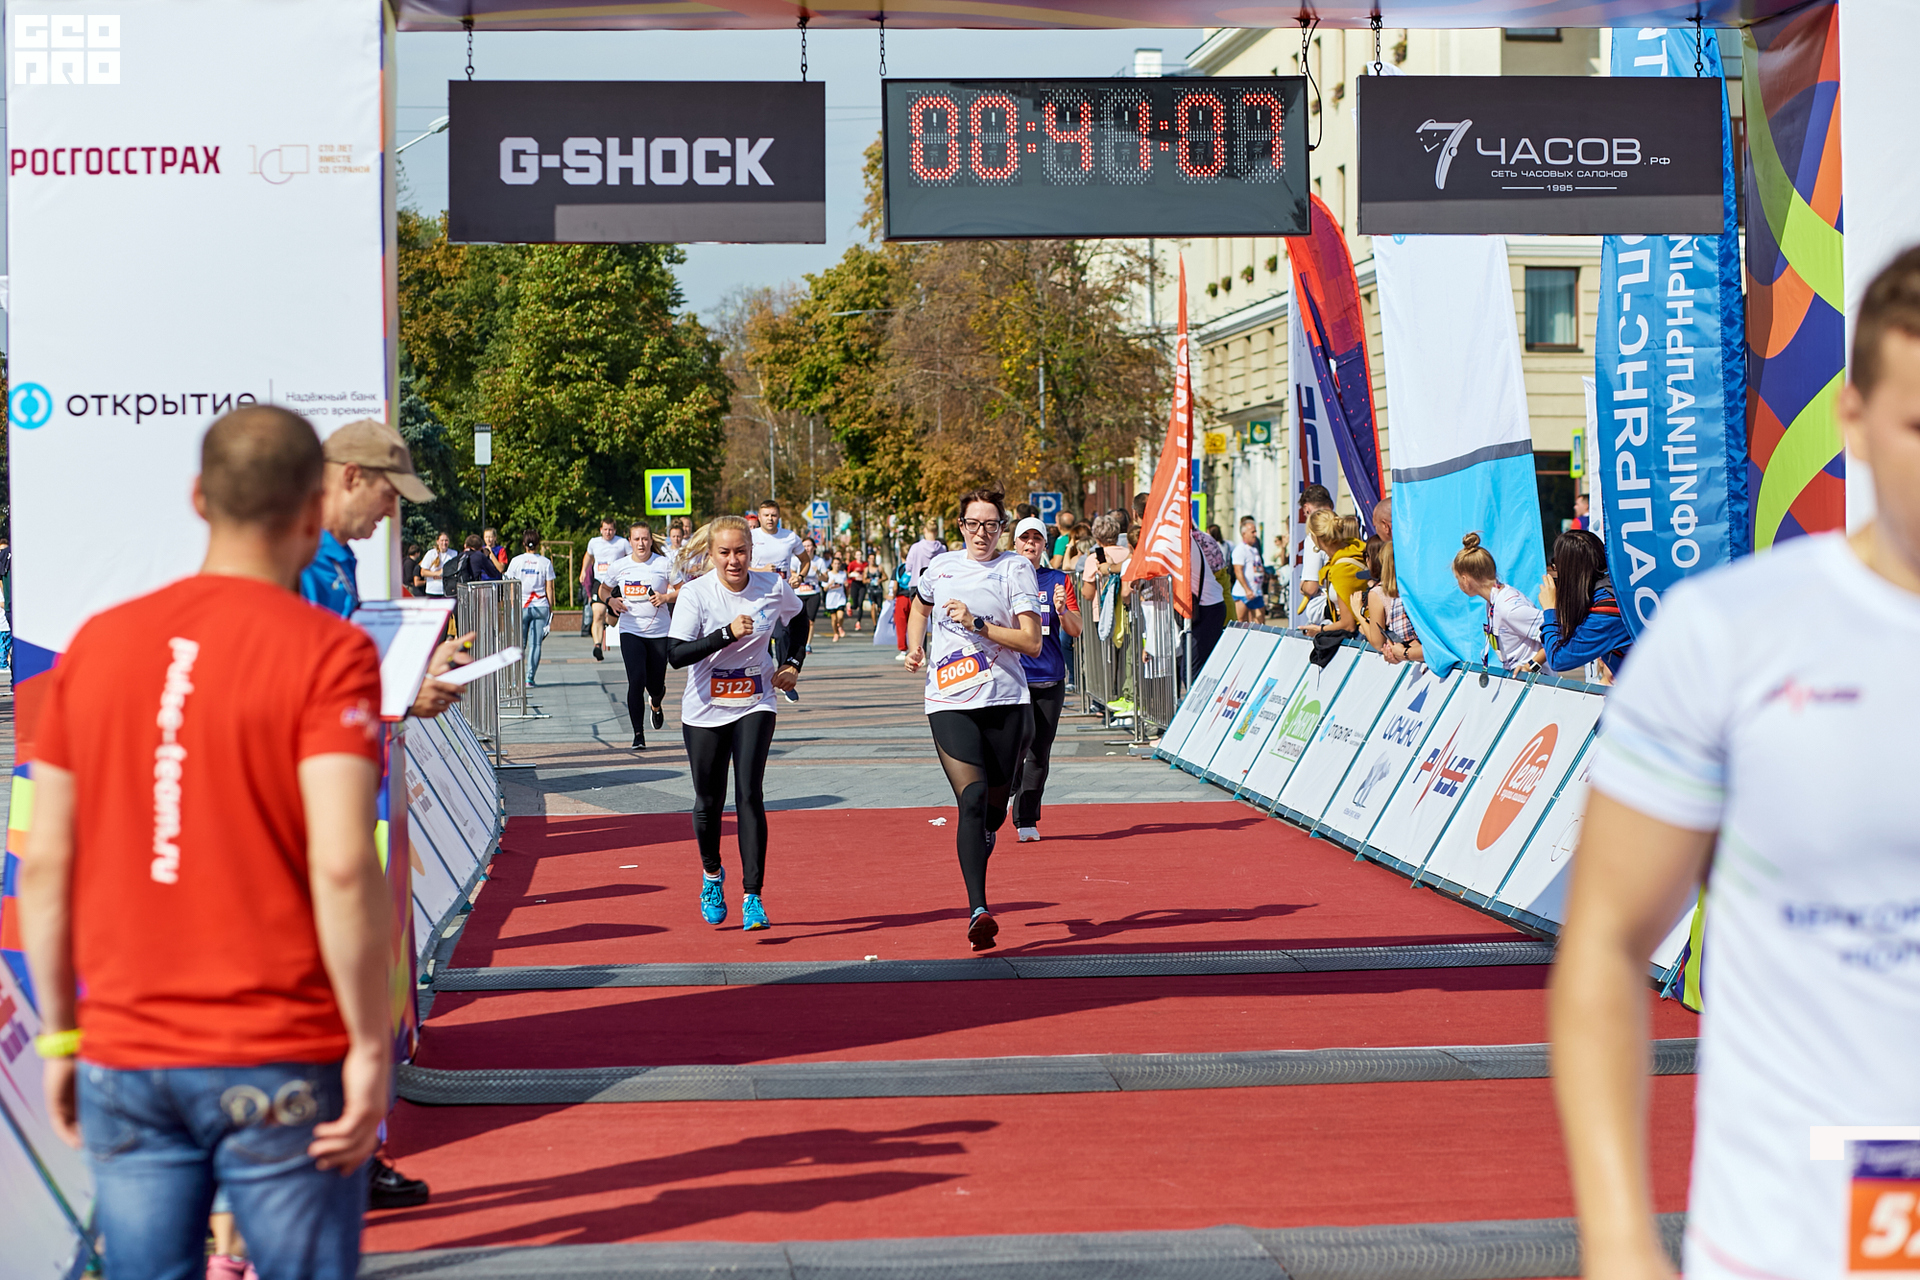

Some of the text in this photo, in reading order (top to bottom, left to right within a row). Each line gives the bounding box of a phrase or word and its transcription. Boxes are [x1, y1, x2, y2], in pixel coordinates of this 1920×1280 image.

[911, 94, 1285, 181] 00:41:07
[10, 146, 221, 176] РОСГОССТРАХ
[500, 136, 775, 186] G-SHOCK
[1491, 170, 1628, 178] СЕТЬ ЧАСОВЫХ САЛОНОВ
[1546, 184, 1574, 192] 1995
[350, 390, 377, 401] банк
[625, 586, 646, 595] 5256
[940, 659, 975, 684] 5060
[714, 680, 752, 694] 5122
